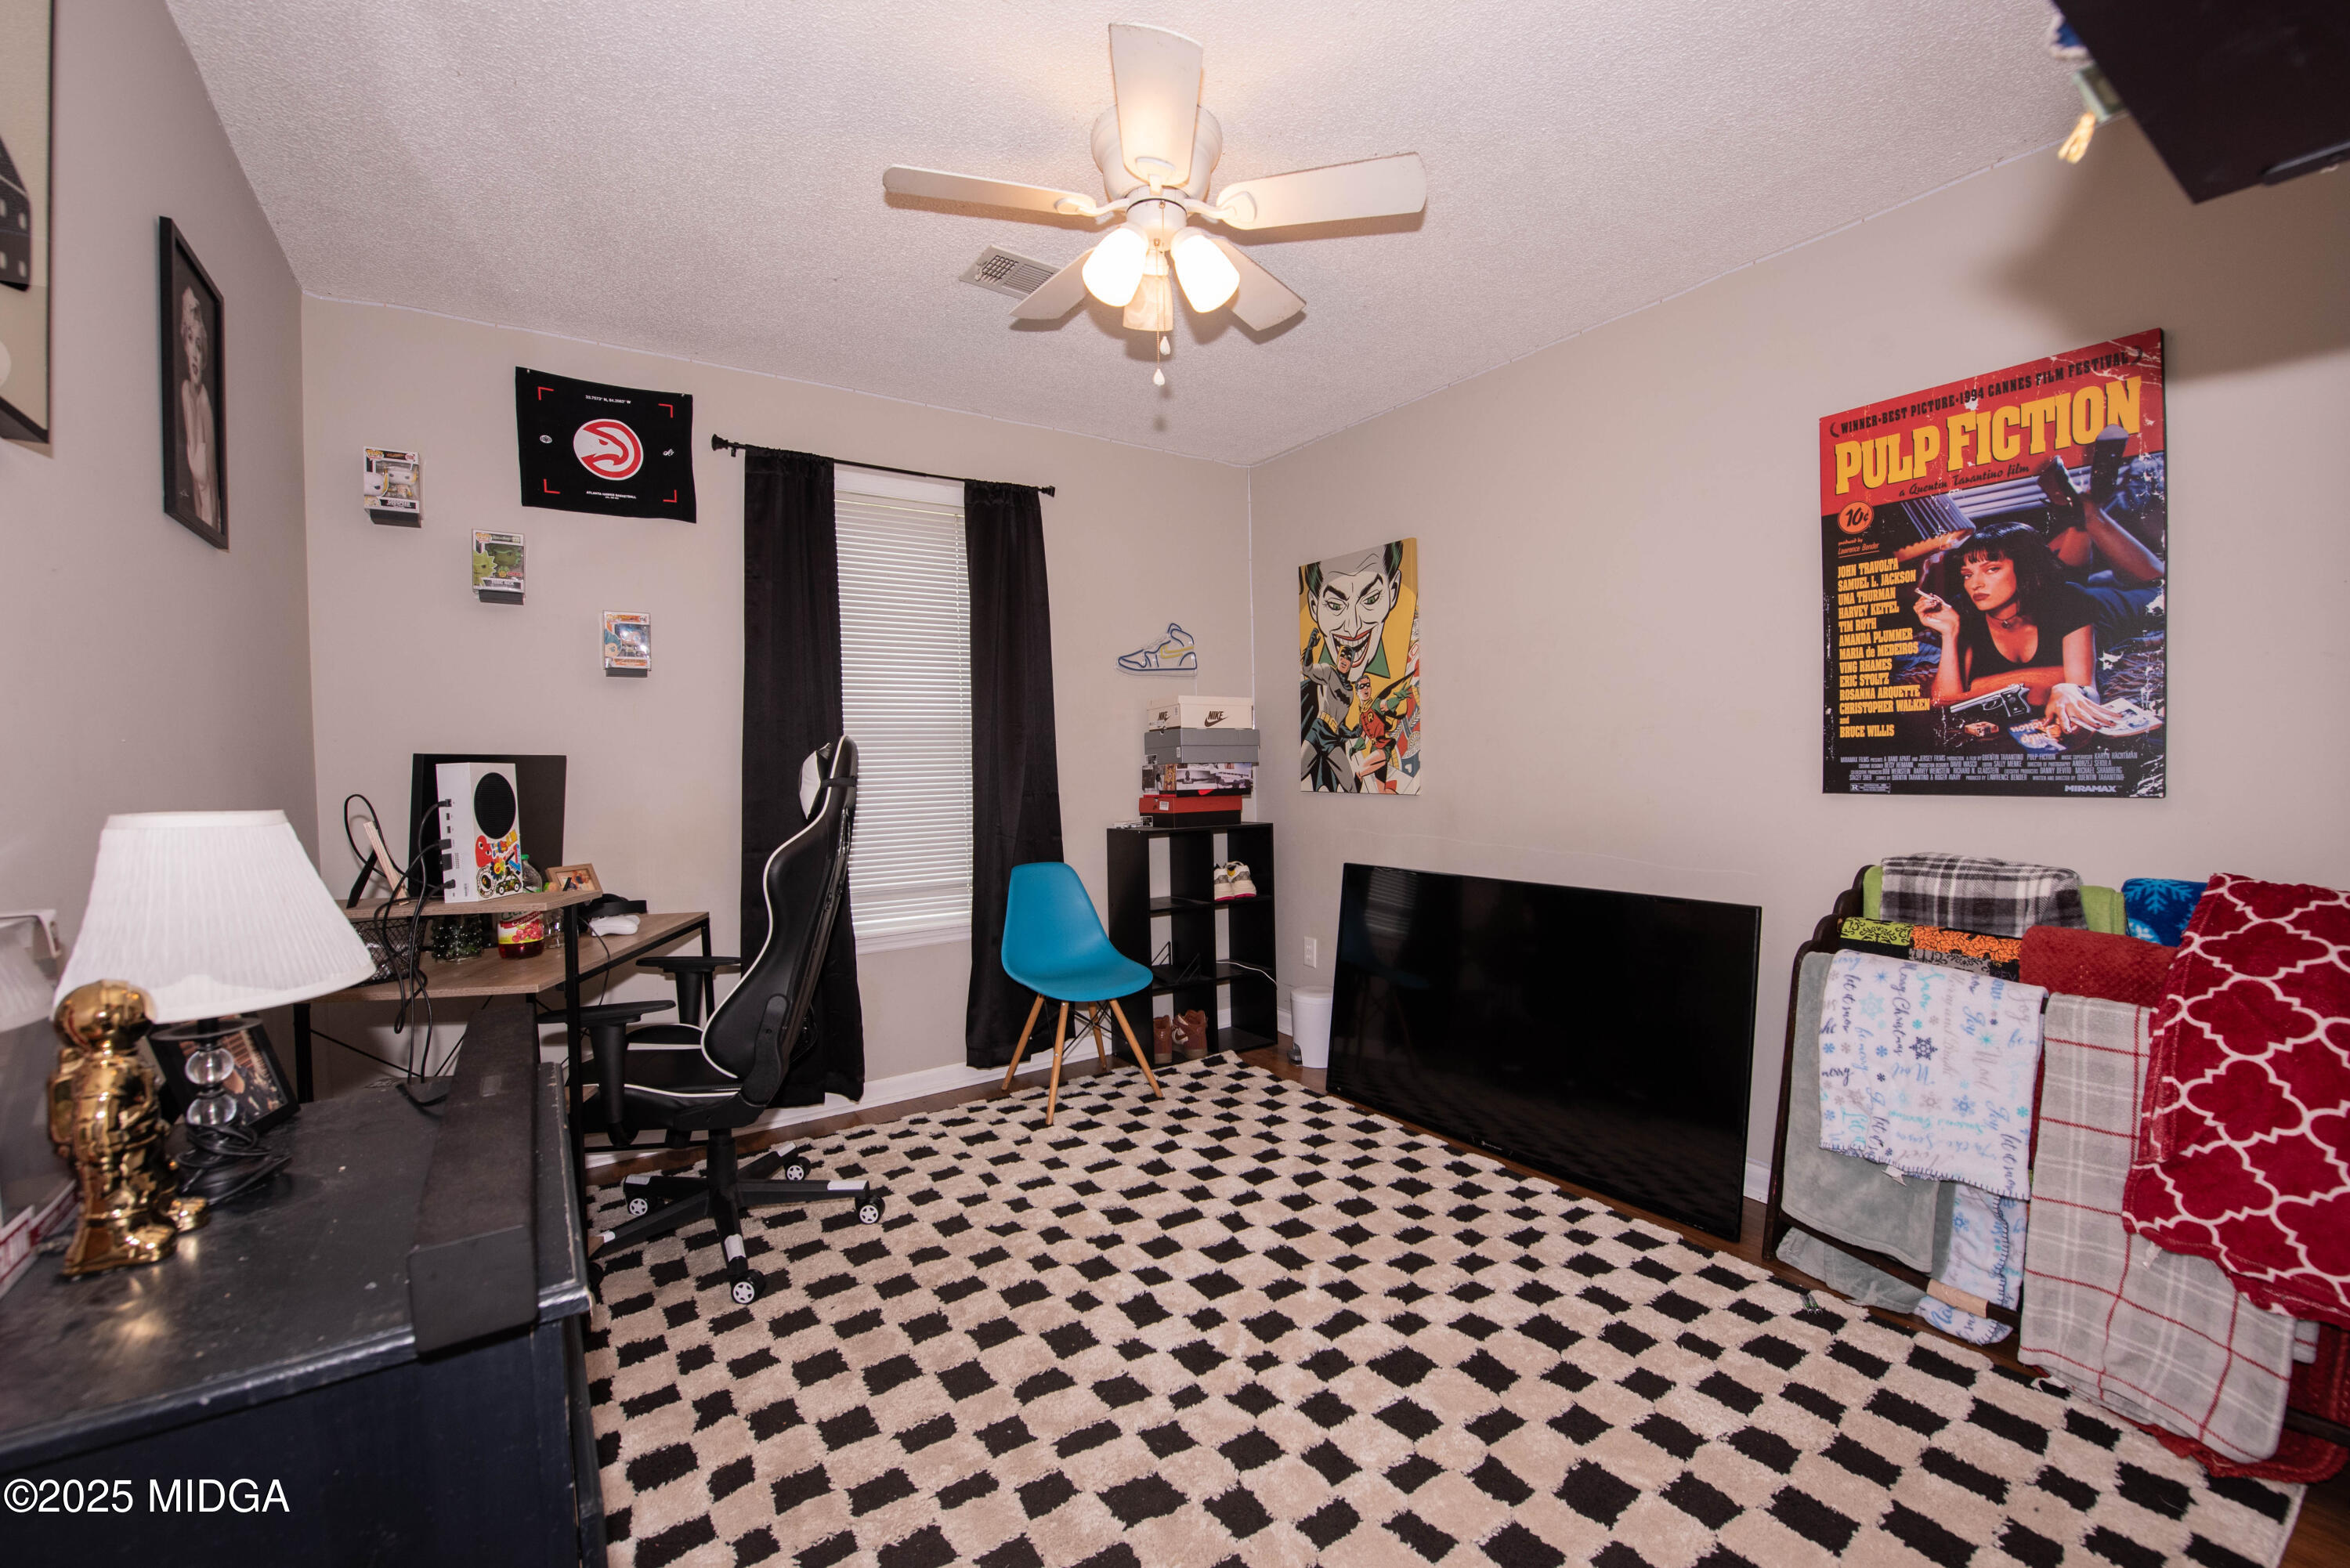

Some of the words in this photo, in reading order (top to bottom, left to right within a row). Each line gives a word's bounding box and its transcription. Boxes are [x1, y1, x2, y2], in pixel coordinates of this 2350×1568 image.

[1841, 415, 1878, 434] WINNER
[1882, 407, 1907, 424] BEST
[1911, 395, 1954, 417] PICTURE
[1960, 387, 1984, 403] 1994
[1988, 375, 2032, 397] CANNES
[2036, 367, 2064, 385] FILM
[2068, 351, 2129, 381] FESTIVAL
[1835, 425, 1940, 495] PULP
[1947, 375, 2142, 472] FICTION
[1909, 479, 1947, 495] Quentin
[1952, 468, 2003, 486] Tarantino
[2007, 461, 2030, 479] film
[1838, 564, 1856, 579] JOHN
[1859, 558, 1899, 575] TRAVOLTA
[1838, 576, 1869, 592] SAMUEL
[1871, 576, 1878, 587] L.
[1881, 569, 1917, 586] JACKSON
[1838, 592, 1855, 605] UMA
[1856, 587, 1896, 603] THURMAN
[1838, 604, 1868, 620] HARVEY
[1871, 601, 1900, 616] KEITEL
[1838, 620, 1853, 633] TIM
[1855, 617, 1877, 631] ROTH
[1839, 632, 1871, 647] AMANDA
[1874, 627, 1913, 643] PLUMMER
[1839, 646, 1864, 660] MARIA
[1866, 645, 1875, 658] de
[1878, 641, 1919, 657] MEDEIROS
[1839, 661, 1857, 674] VING
[1859, 658, 1892, 673] RHAMES
[1839, 674, 1857, 688] ERIC
[1860, 672, 1889, 687] STOLTZ
[1839, 687, 1875, 701] ROSANNA
[1878, 685, 1921, 699] ARQUETTE
[1208, 710, 1224, 721] NIKE
[1839, 700, 1894, 715] CHRISTOPHER
[1896, 698, 1930, 712] WALKEN
[1839, 715, 1849, 724] and
[1839, 725, 1865, 738] BRUCE
[1867, 724, 1895, 737] WILLIS
